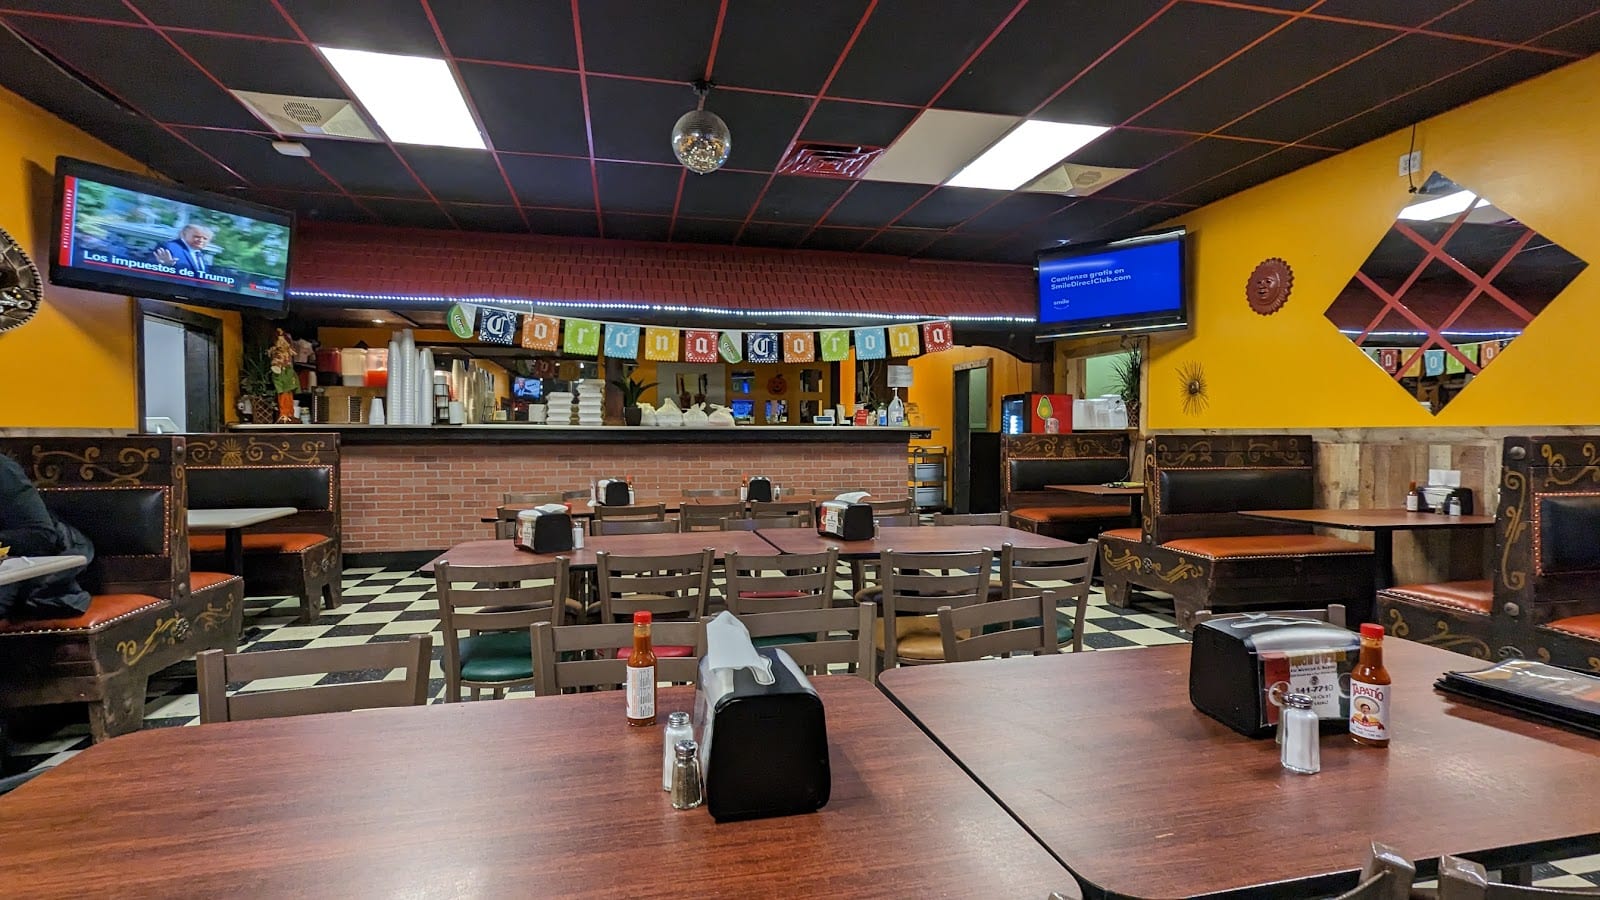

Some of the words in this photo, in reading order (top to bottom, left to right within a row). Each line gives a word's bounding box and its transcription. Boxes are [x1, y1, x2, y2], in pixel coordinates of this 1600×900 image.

[83, 250, 108, 263] Los
[111, 255, 176, 274] impuestos
[179, 267, 195, 277] de
[197, 271, 235, 285] Trump
[1050, 273, 1088, 283] Comienza
[1089, 269, 1113, 279] gratis
[1050, 274, 1131, 290] SmileDirectClub.com
[1053, 298, 1070, 306] smile
